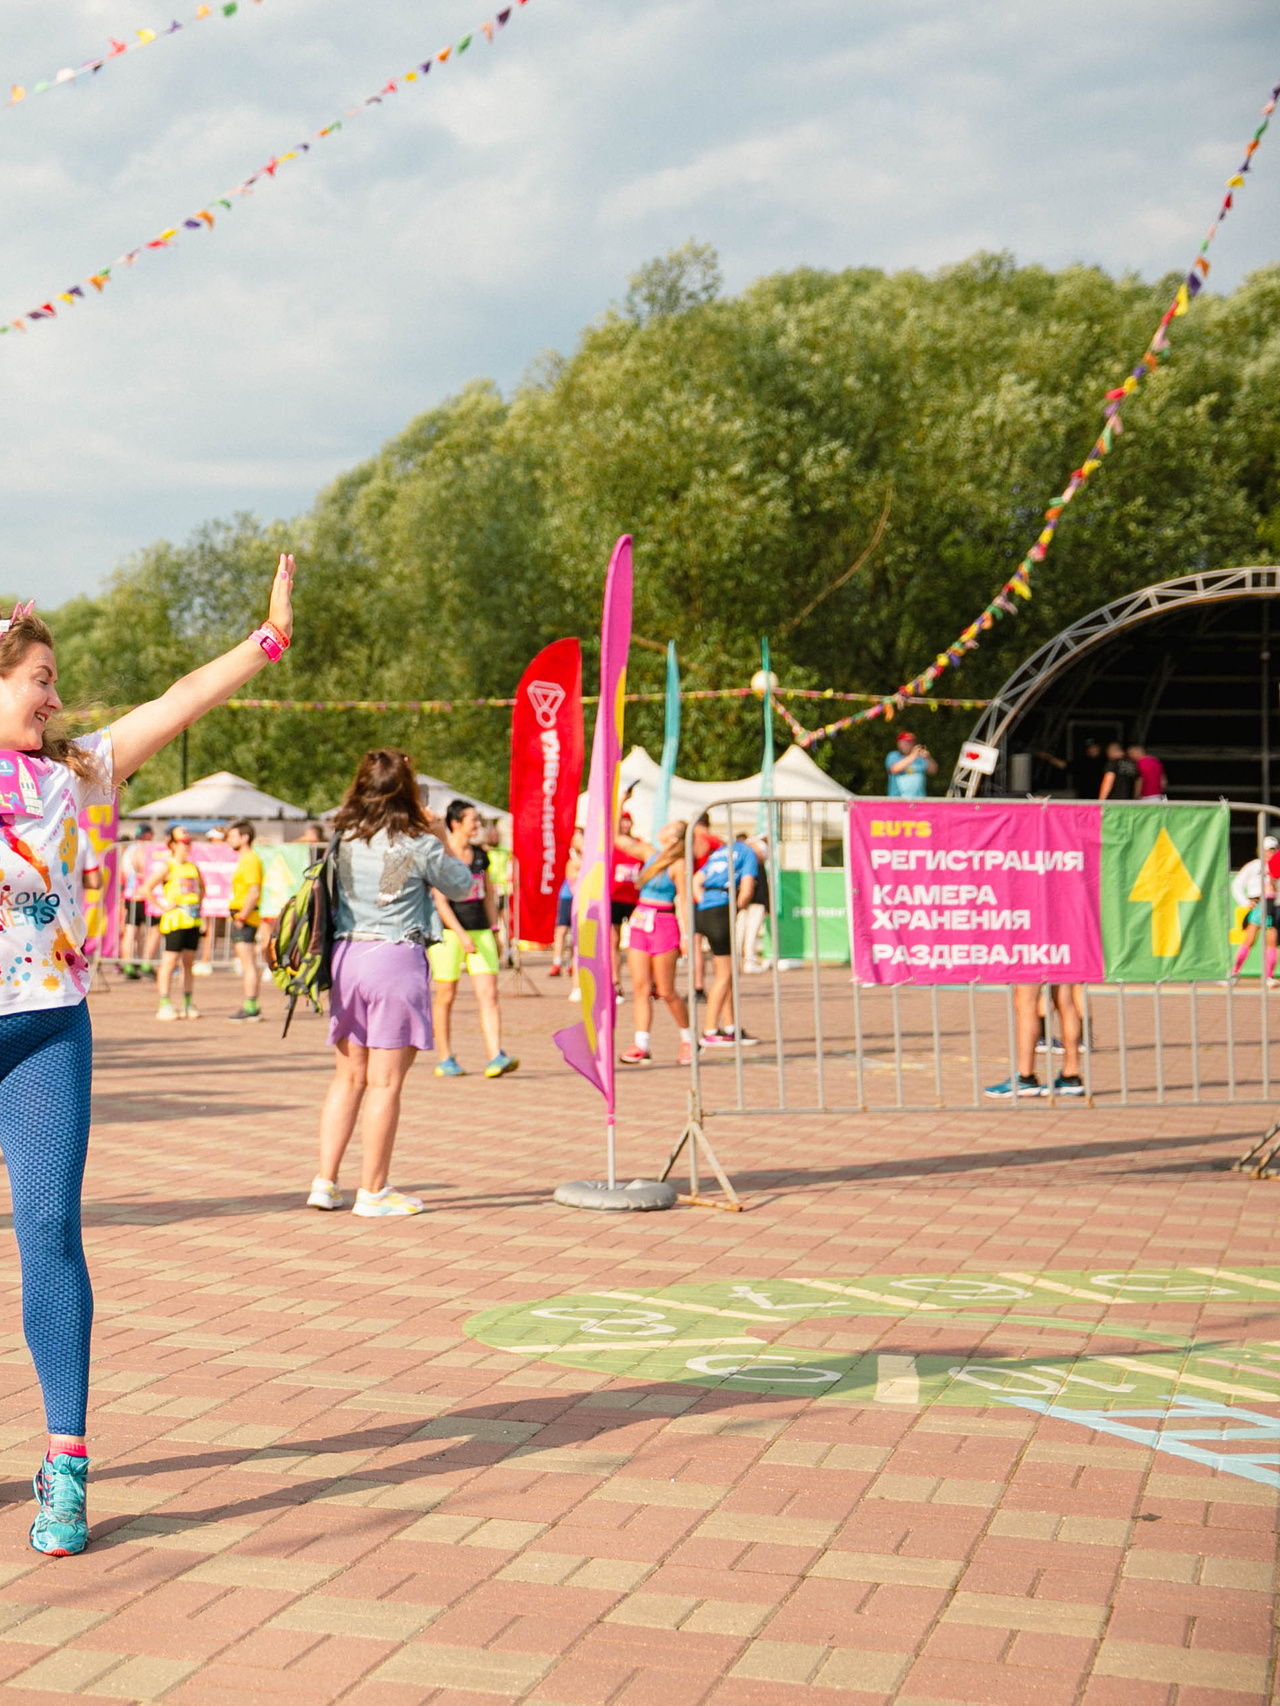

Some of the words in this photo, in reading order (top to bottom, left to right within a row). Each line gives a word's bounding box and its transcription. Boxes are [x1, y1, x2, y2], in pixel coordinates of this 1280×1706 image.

[540, 729, 561, 895] ГРАВИРОВКА
[870, 820, 932, 838] RUTS
[870, 849, 1084, 875] РЕГИСТРАЦИЯ
[871, 884, 998, 906] КАМЕРА
[870, 908, 1031, 931] ХРАНЕНИЯ
[871, 943, 1071, 970] РАЗДЕВАЛКИ
[530, 1305, 678, 1337] 8
